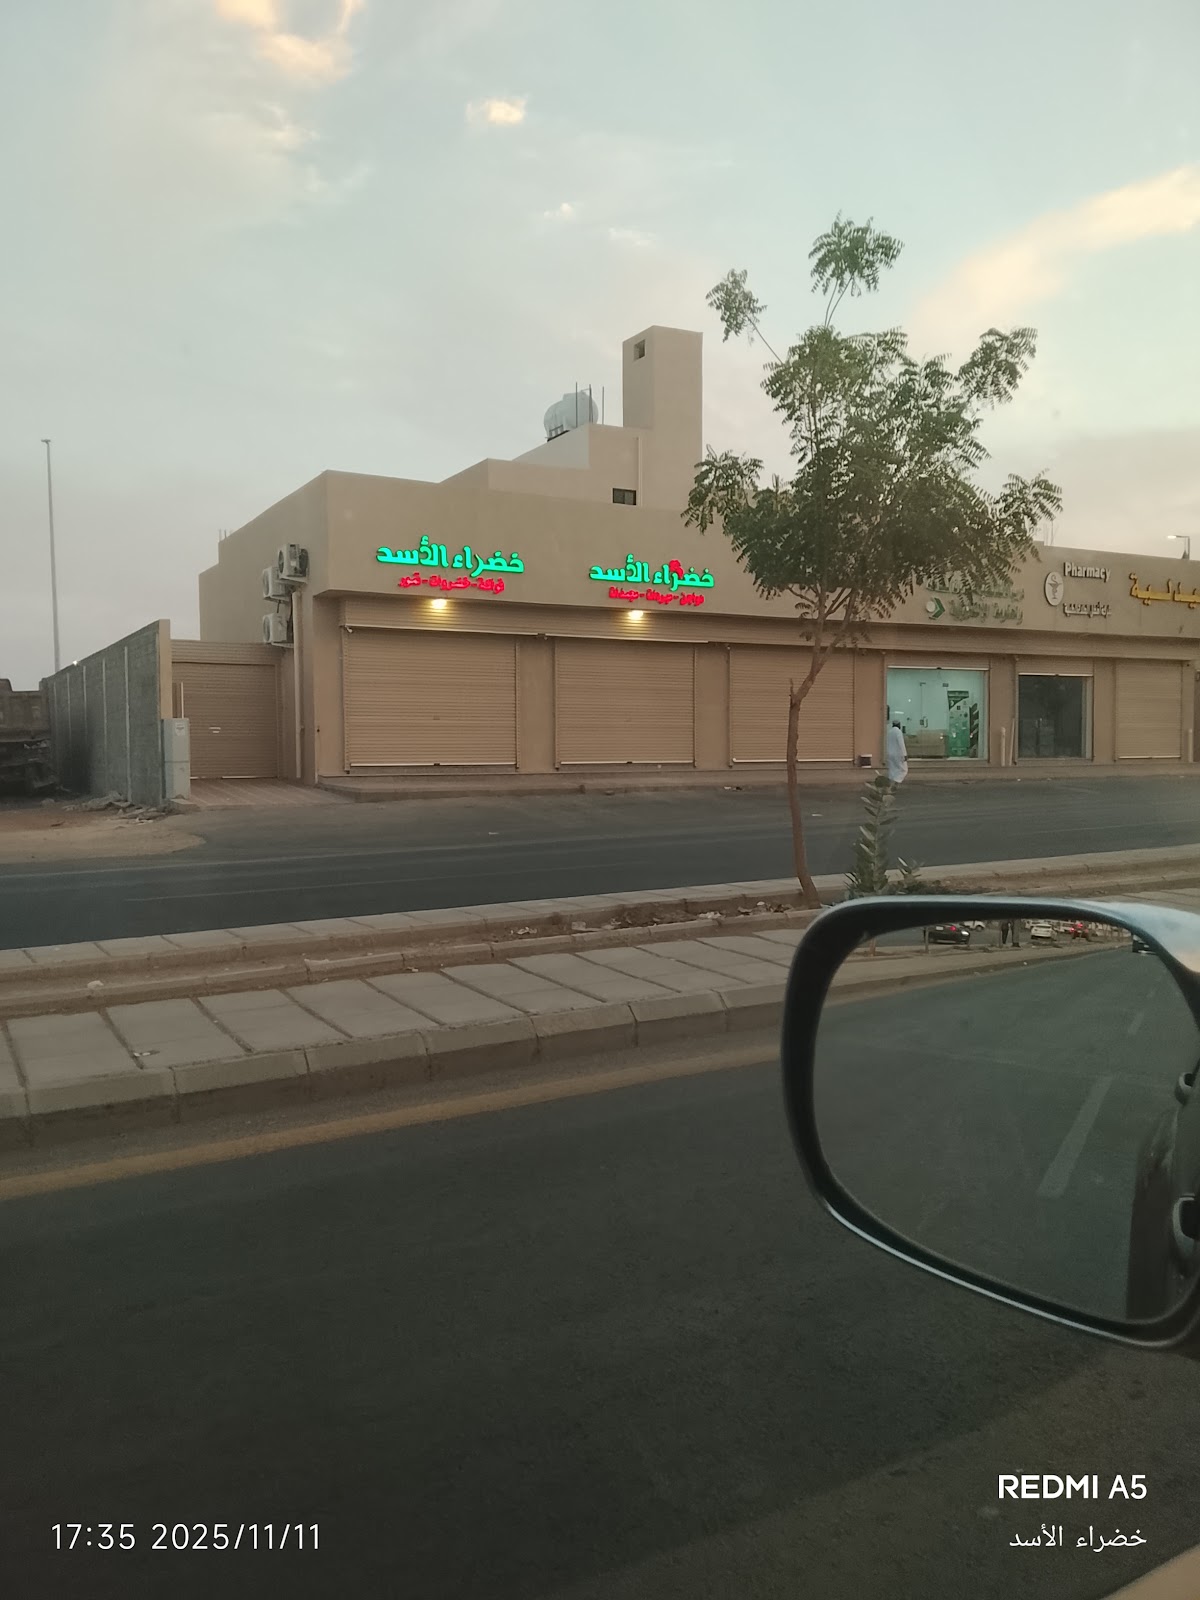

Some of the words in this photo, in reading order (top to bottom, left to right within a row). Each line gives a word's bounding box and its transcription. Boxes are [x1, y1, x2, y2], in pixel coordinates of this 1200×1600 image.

[376, 535, 449, 568] الأسد
[451, 545, 525, 577] خضراء
[589, 553, 650, 583] الأسد
[652, 564, 715, 592] خضراء
[1064, 562, 1111, 583] Pharmacy
[1129, 572, 1200, 609] يدلية
